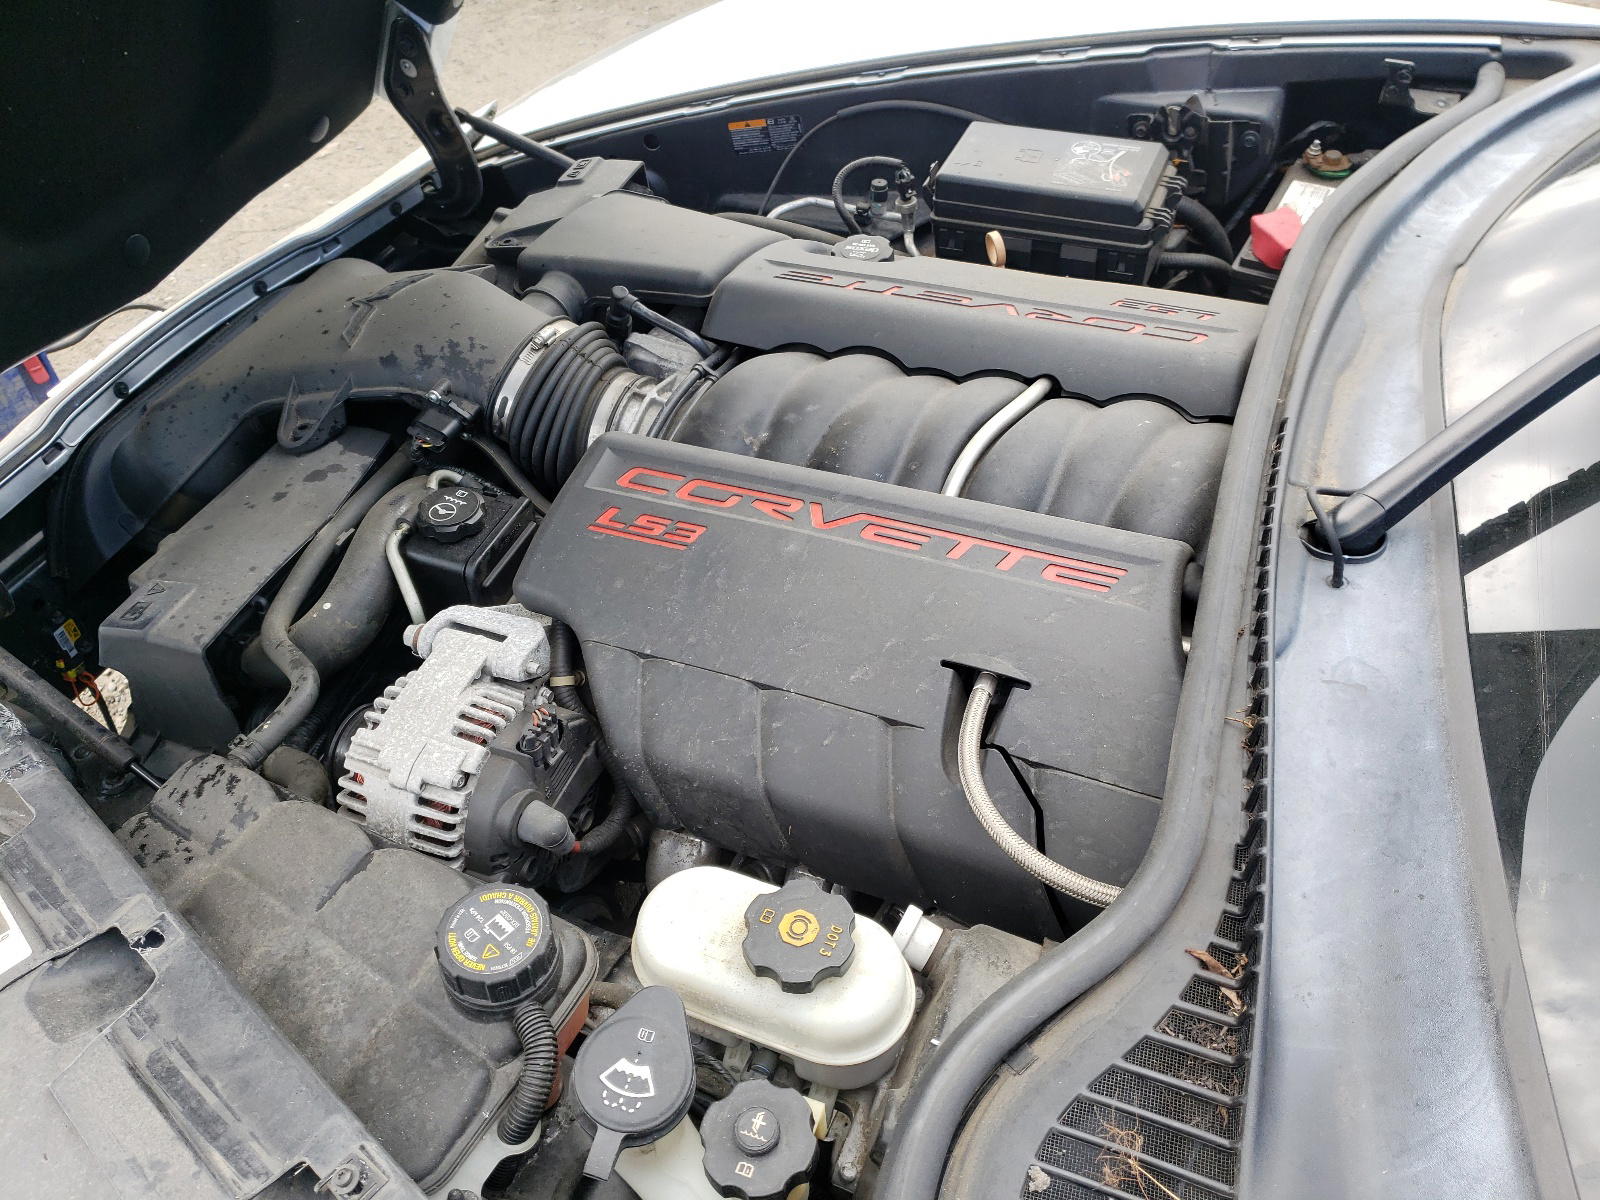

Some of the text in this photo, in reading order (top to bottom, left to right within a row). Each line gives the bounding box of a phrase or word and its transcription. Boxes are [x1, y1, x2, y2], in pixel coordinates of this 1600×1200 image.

[773, 270, 1209, 344] CORVETTE
[1109, 297, 1221, 320] LS3
[587, 506, 708, 550] LS3
[616, 466, 1128, 593] CORVETTE
[480, 892, 506, 902] CHAUD!
[513, 894, 535, 912] OUVRIR
[819, 924, 843, 957] DOT 3
[450, 945, 466, 962] OPEN
[463, 958, 486, 971] NEVER
